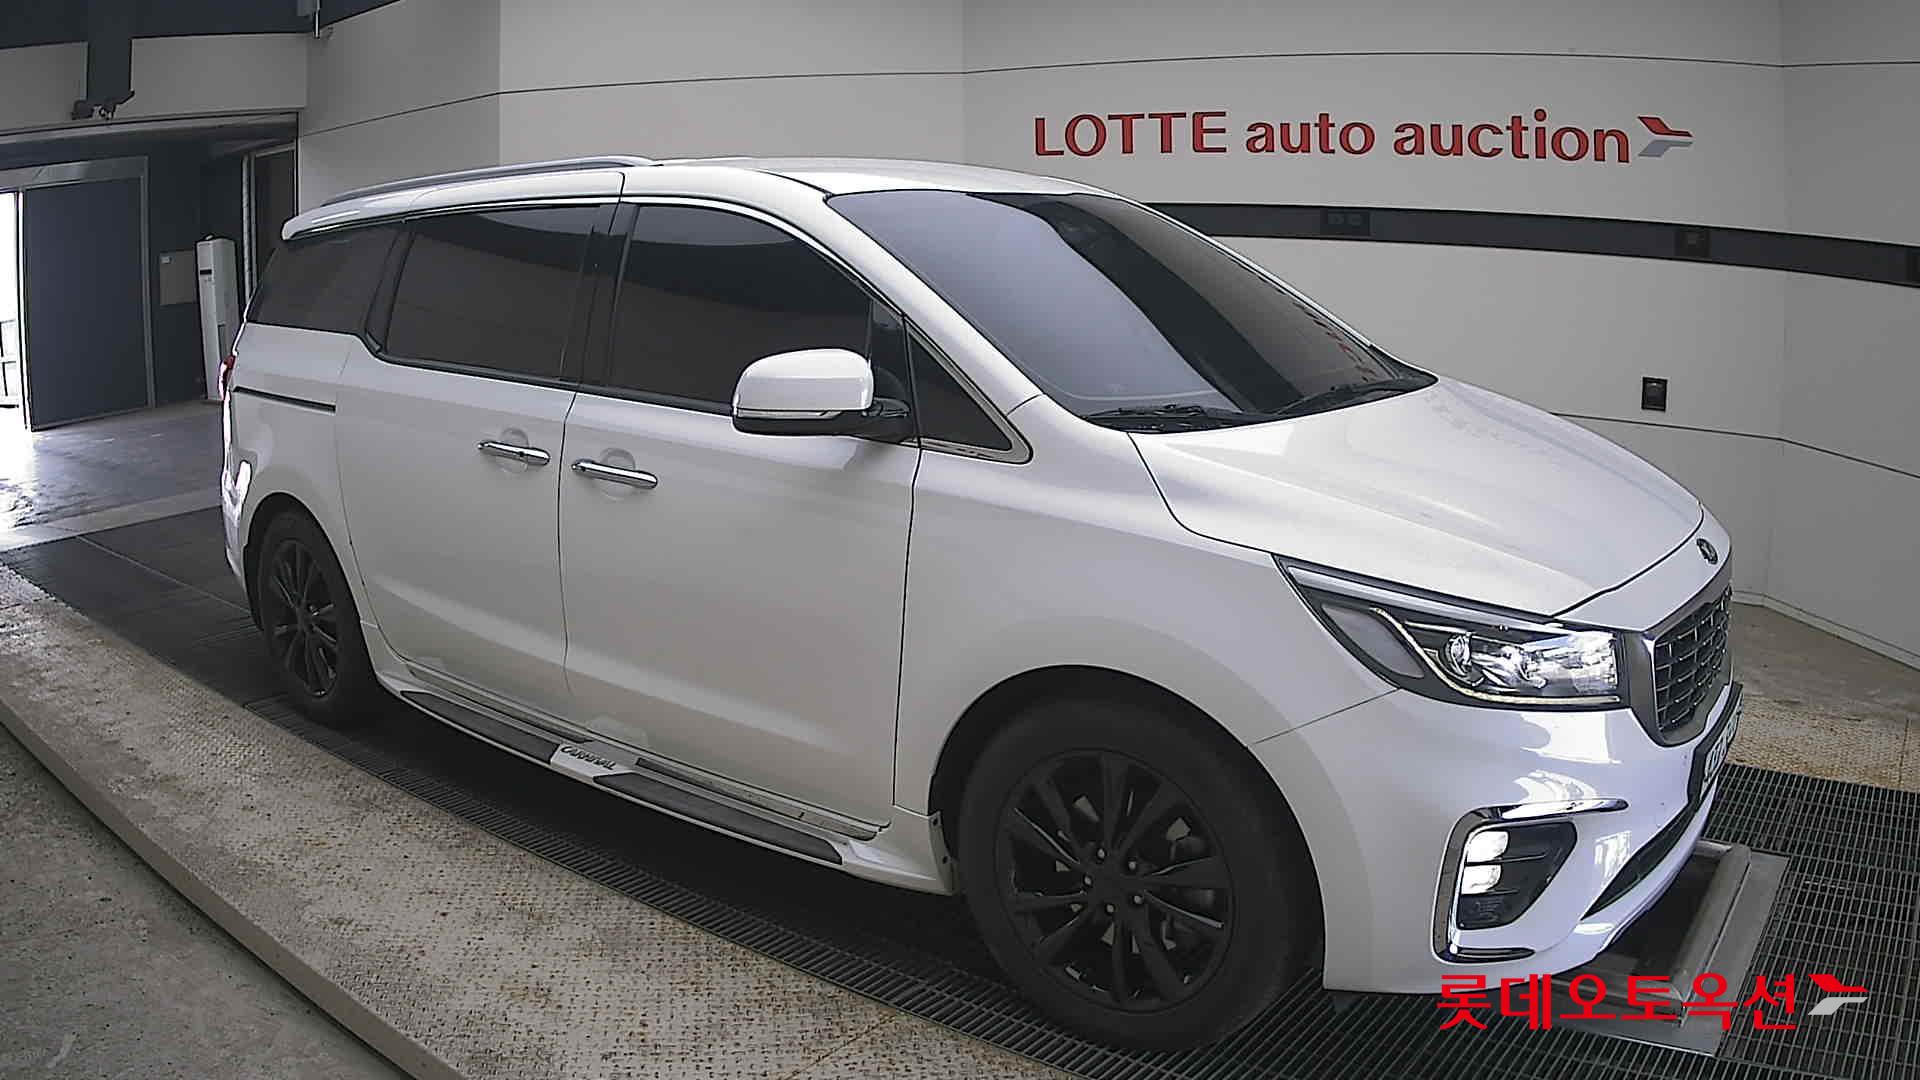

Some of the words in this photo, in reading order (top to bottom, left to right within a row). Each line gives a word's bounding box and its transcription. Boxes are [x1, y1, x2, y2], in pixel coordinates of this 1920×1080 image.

[1034, 111, 1227, 157] LOTTE
[1246, 113, 1377, 156] auto
[1393, 109, 1631, 163] auction
